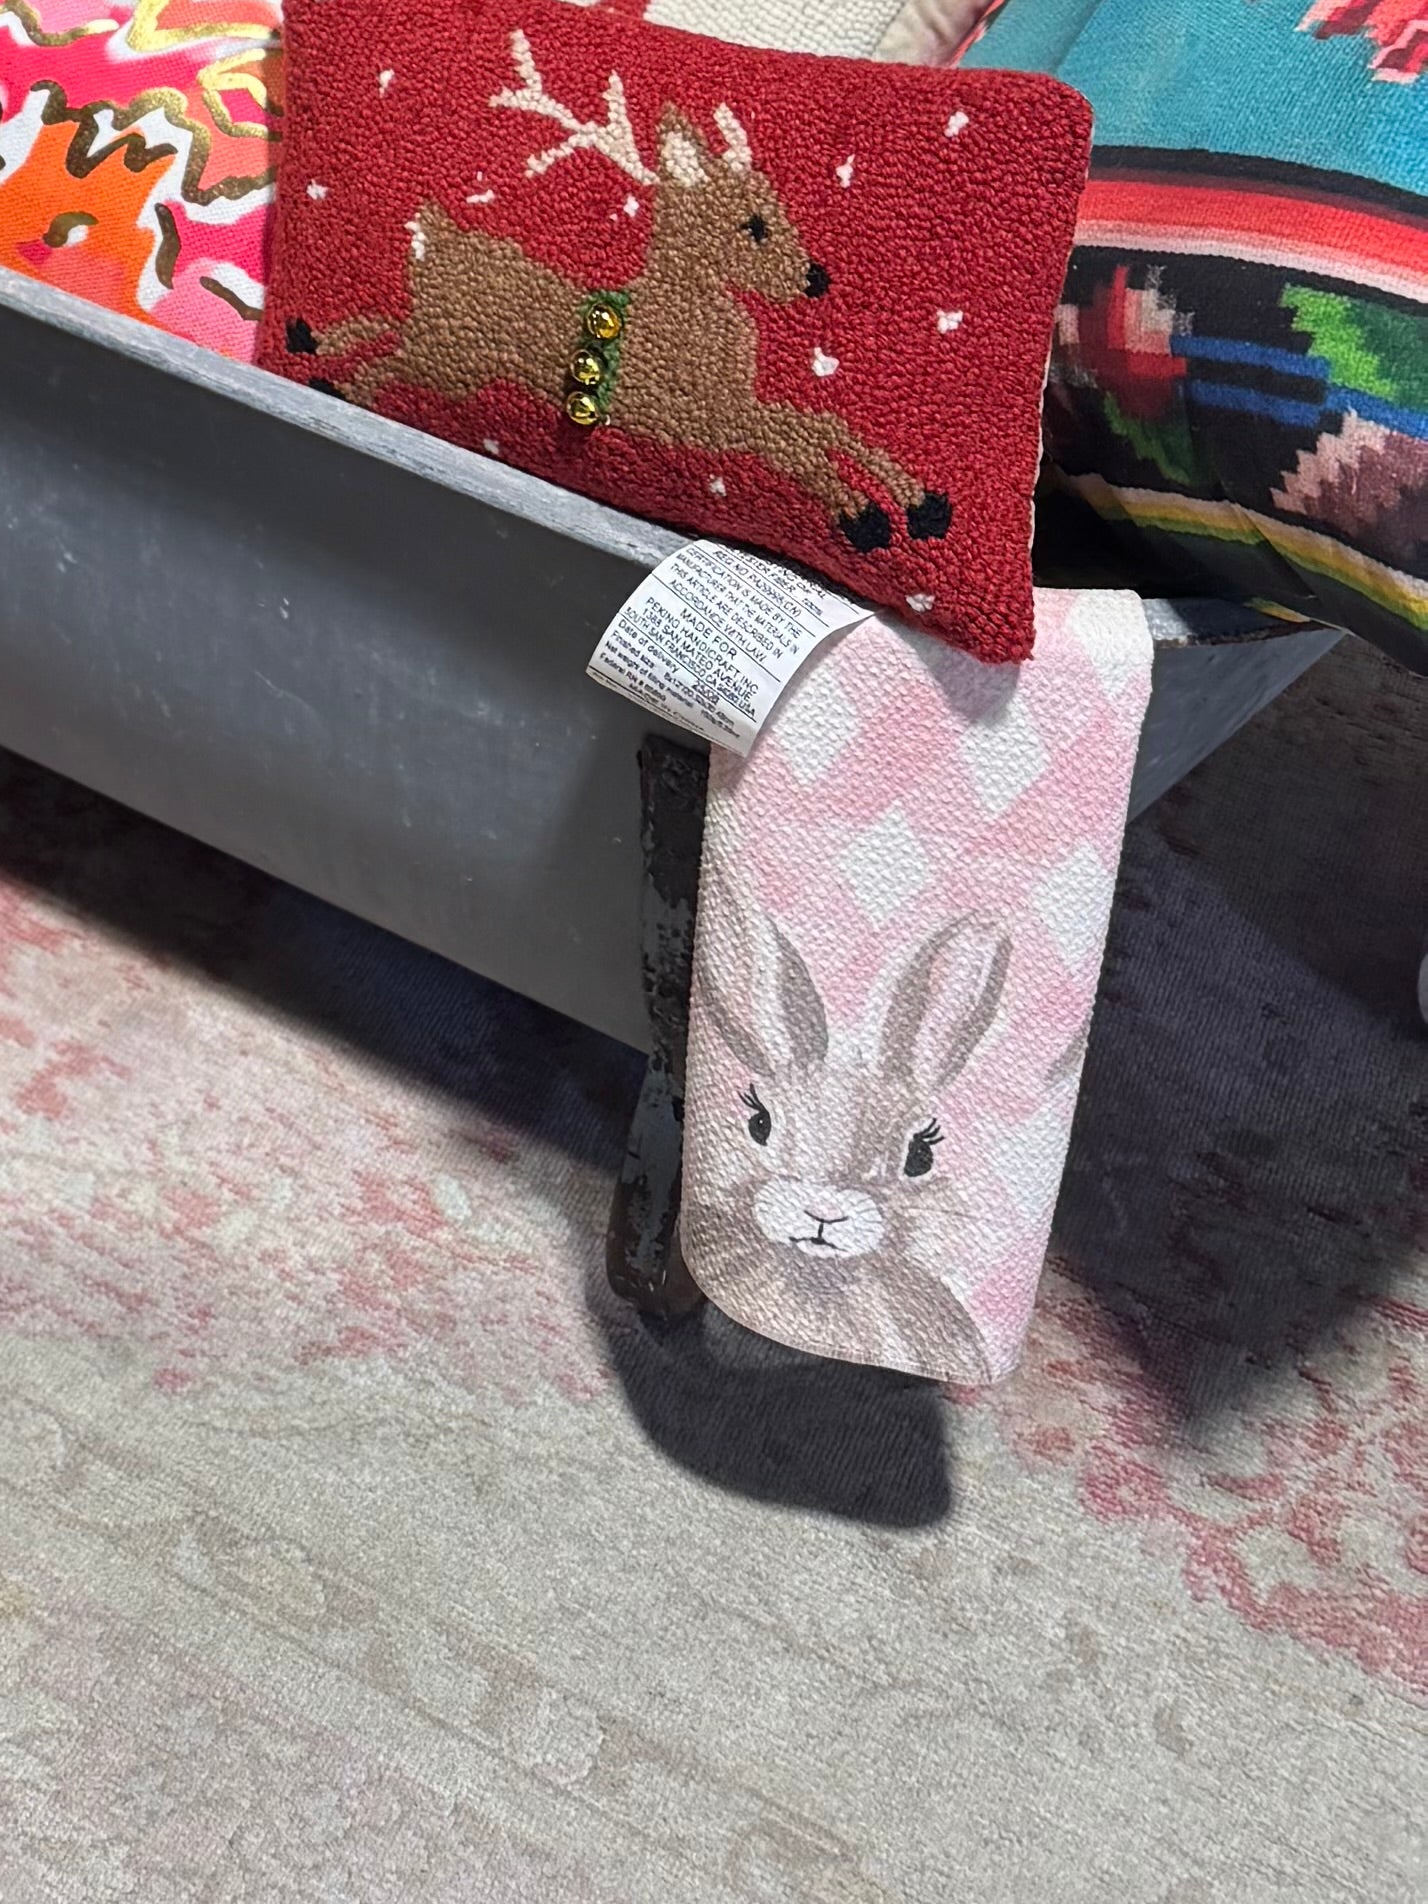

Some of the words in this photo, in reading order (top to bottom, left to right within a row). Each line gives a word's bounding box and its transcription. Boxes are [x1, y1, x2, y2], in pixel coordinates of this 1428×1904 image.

[667, 577, 727, 627] ACCORDANCE
[670, 562, 688, 579] THIS
[685, 575, 718, 603] ARTICLE
[714, 598, 733, 616] ARE
[729, 611, 776, 651] DESCRIBED
[685, 544, 742, 591] CERTIFICATION
[749, 594, 773, 616] MADE
[771, 612, 785, 625] BY
[783, 621, 802, 639] THE
[617, 618, 640, 639] Date
[644, 643, 680, 674] delivery
[623, 606, 651, 630] SOUTH
[647, 626, 665, 643] SAN
[662, 639, 707, 677] FRANCISCO
[704, 673, 719, 687] CA
[644, 596, 682, 629] PEKING
[678, 625, 742, 679] HANDICRAFT
[660, 624, 682, 643] SAN
[679, 640, 714, 670] MATEO
[678, 607, 714, 639] MADE
[710, 635, 739, 660] FOR
[752, 613, 792, 647] MATERIALS
